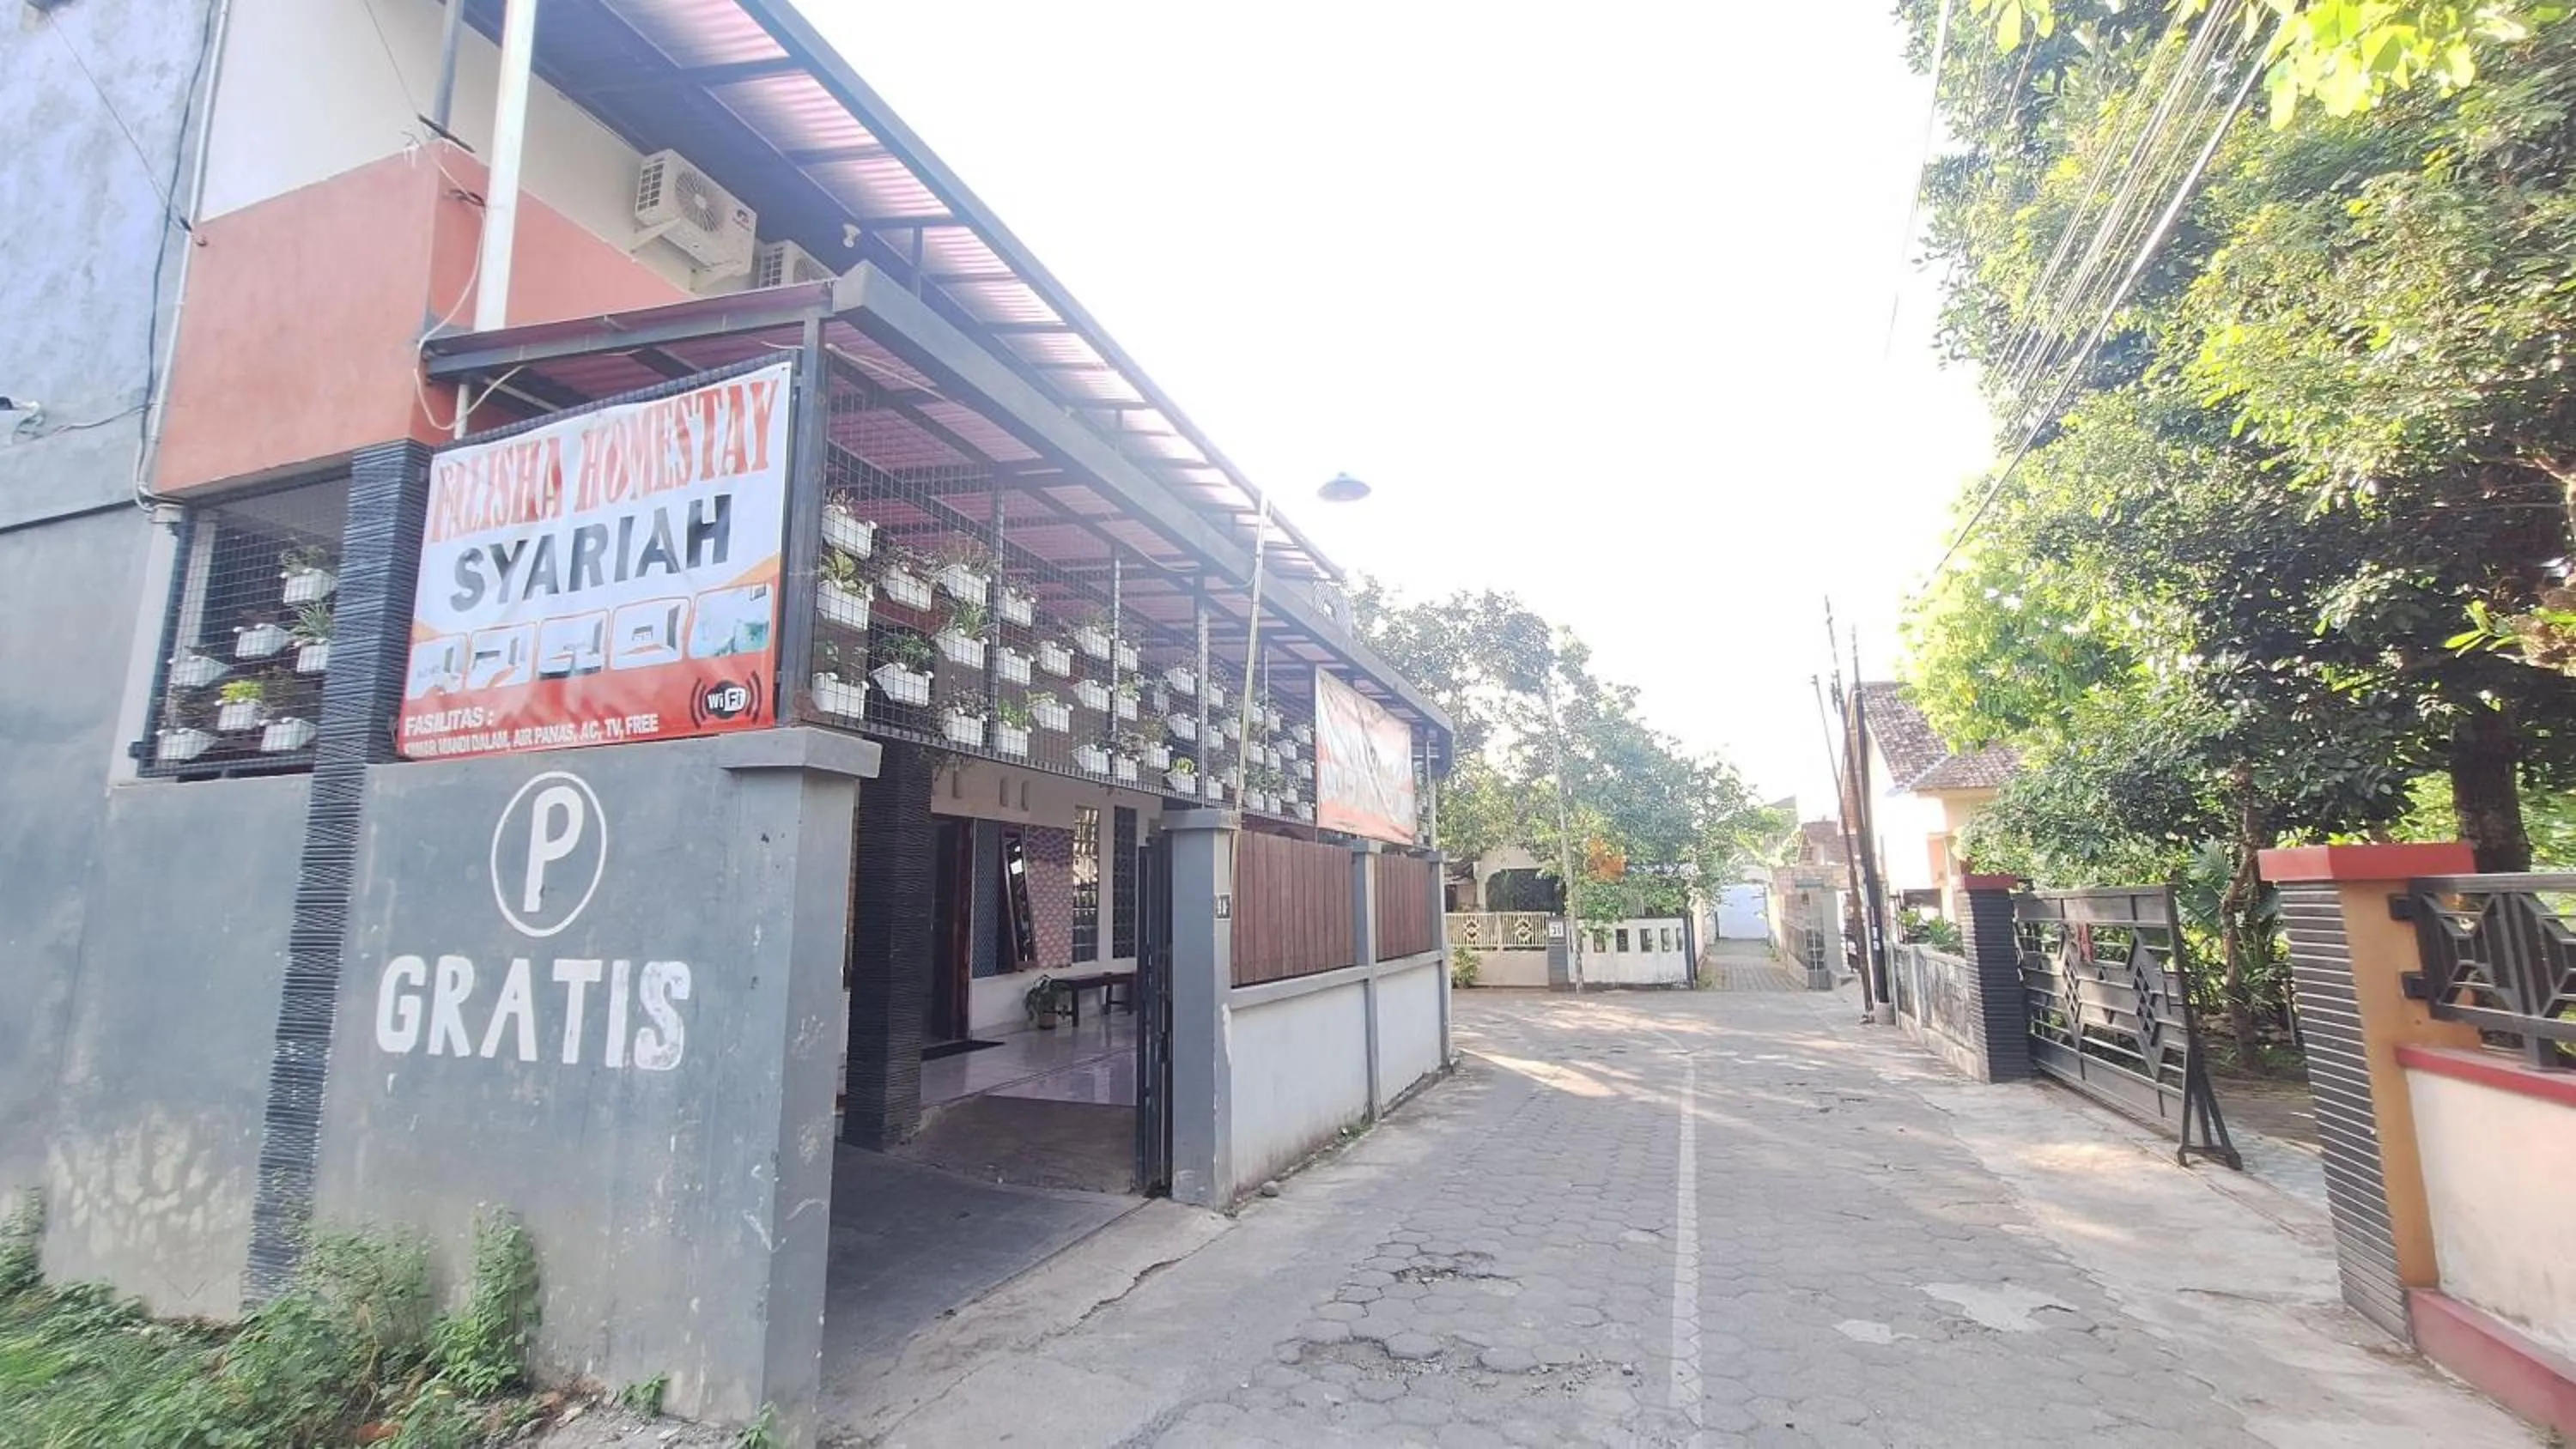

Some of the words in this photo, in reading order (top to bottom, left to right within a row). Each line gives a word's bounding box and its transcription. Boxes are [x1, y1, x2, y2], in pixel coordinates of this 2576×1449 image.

[574, 378, 780, 512] HOMESTAY
[449, 494, 733, 614] SYARIAH
[404, 706, 484, 737] FASILITAS
[513, 727, 532, 748] AIR
[625, 713, 660, 736] FREE
[523, 785, 584, 912] P
[375, 955, 692, 1071] GRATIS
